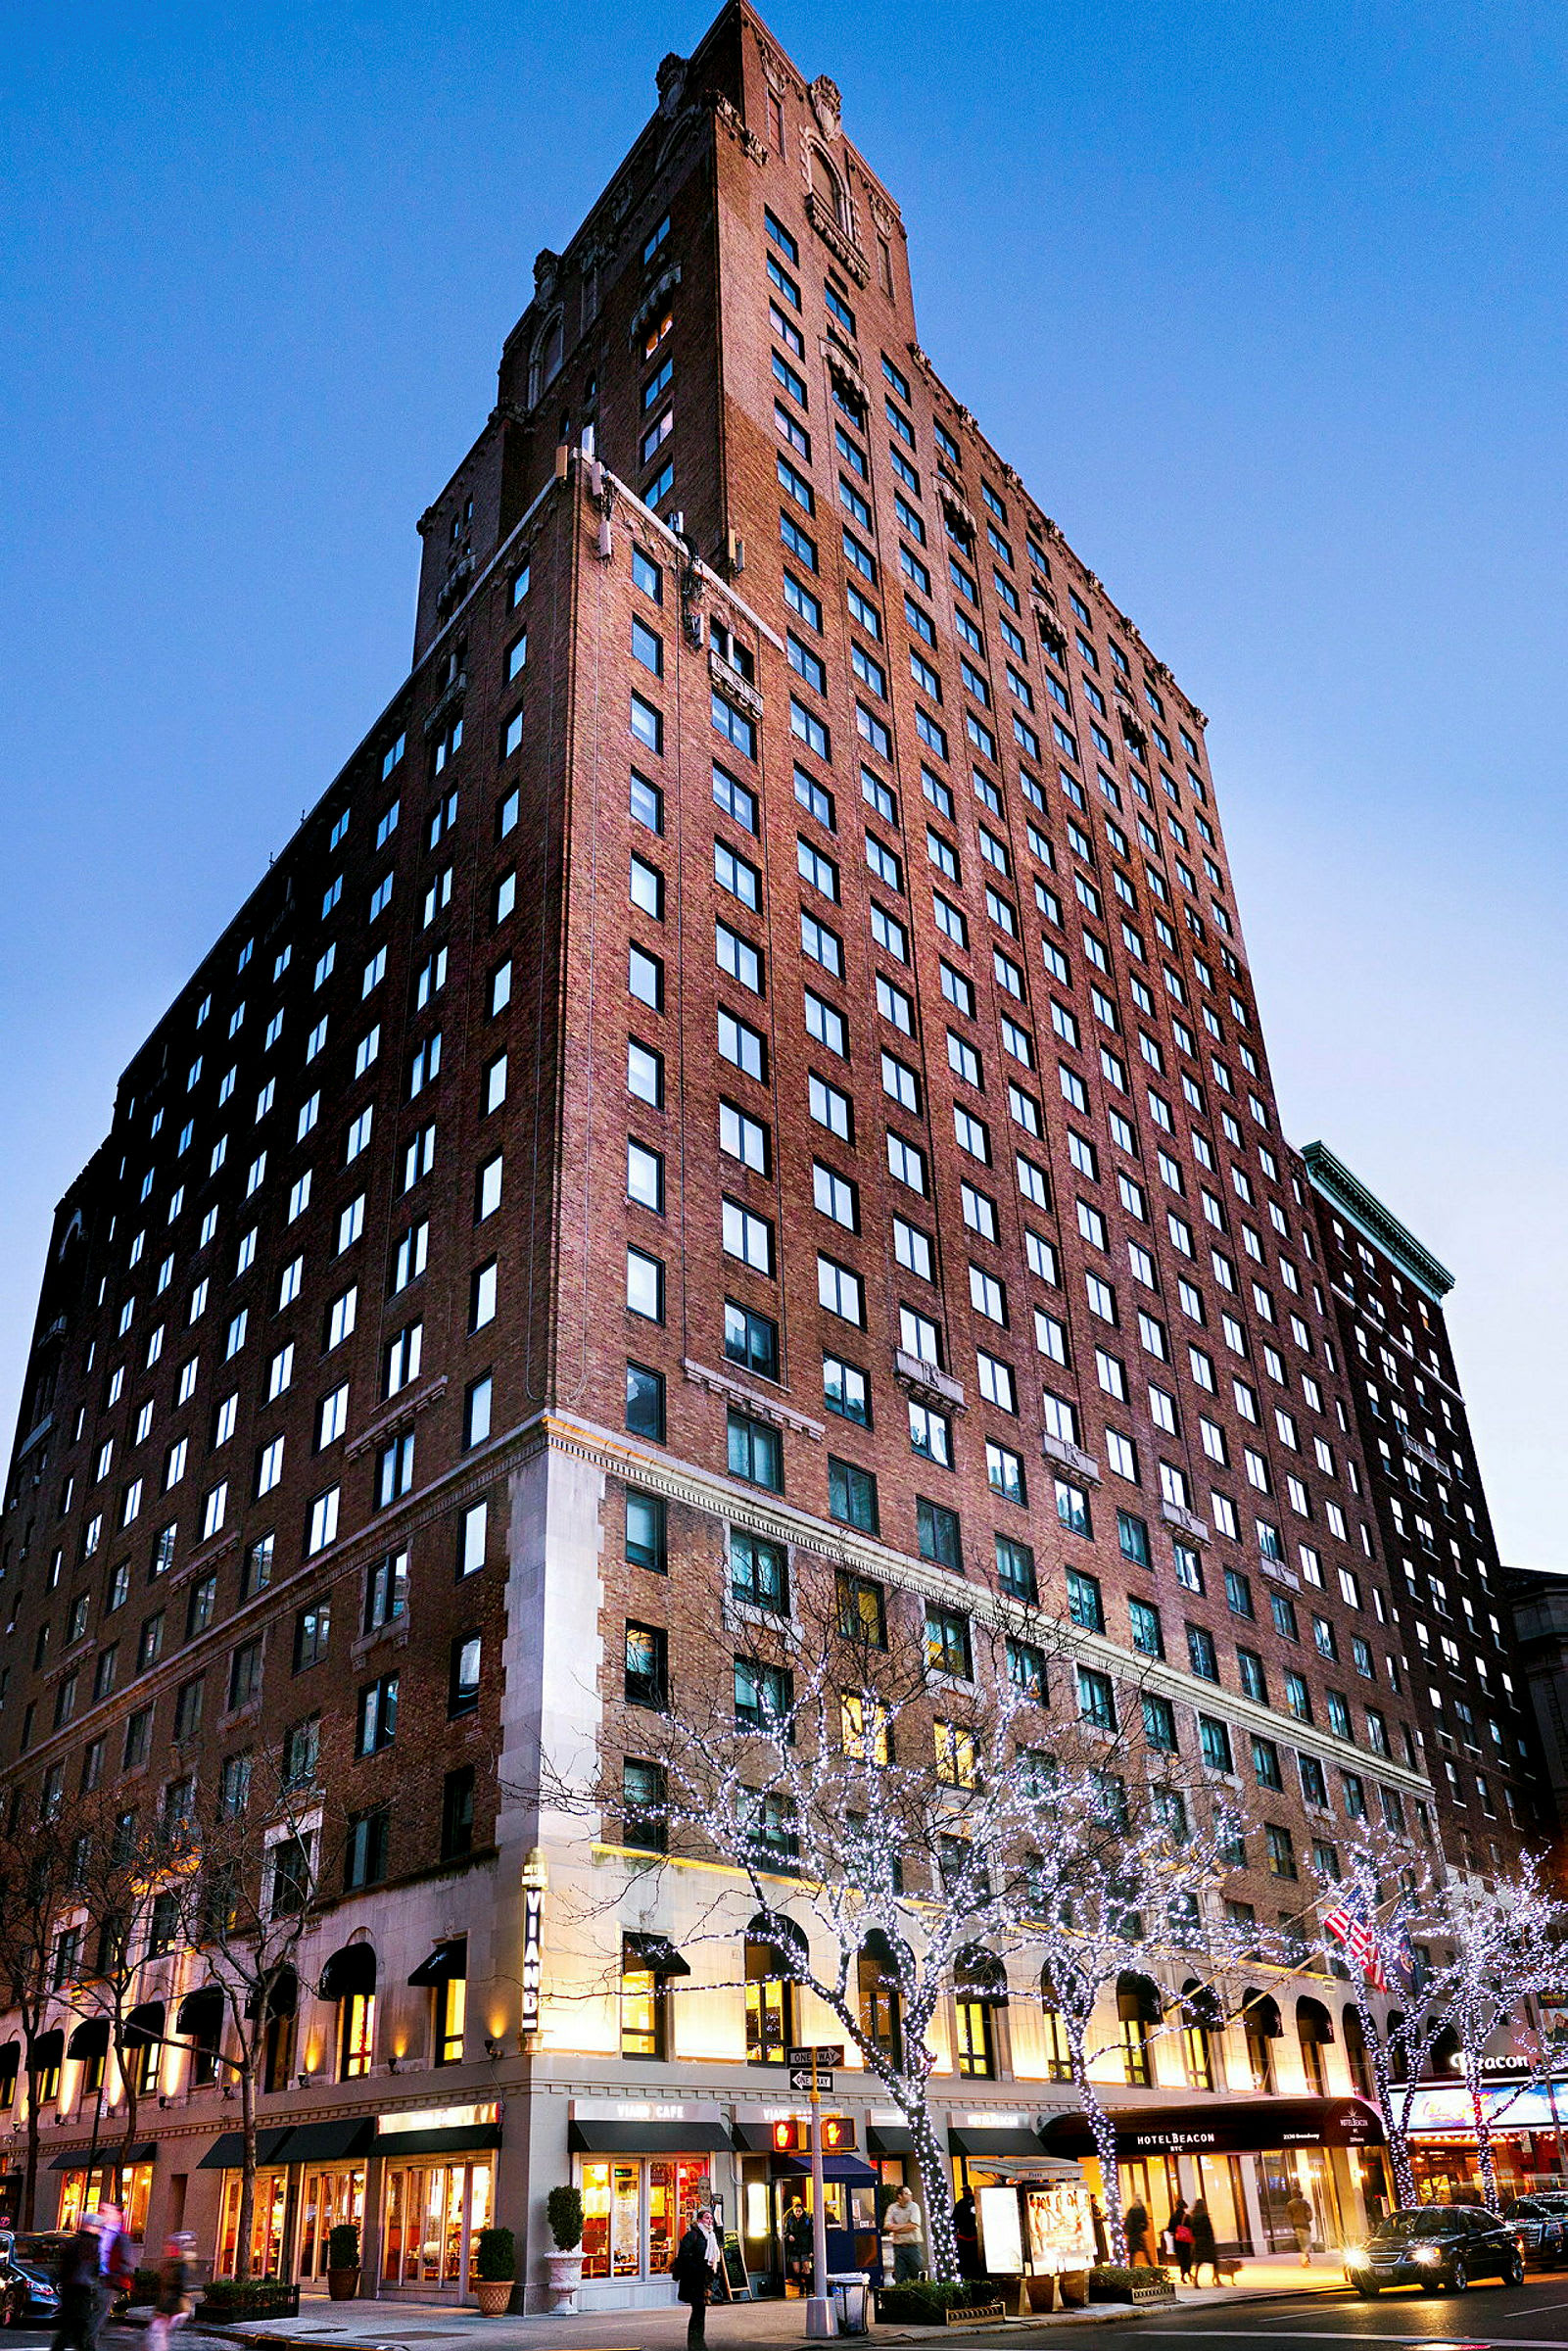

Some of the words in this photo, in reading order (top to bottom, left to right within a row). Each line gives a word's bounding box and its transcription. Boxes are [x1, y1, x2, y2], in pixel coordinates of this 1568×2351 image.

[523, 1891, 541, 2014] VIAND
[794, 2053, 812, 2063] ONE
[818, 2051, 836, 2062] WAY
[796, 2076, 810, 2085] ONE
[617, 2105, 650, 2119] VIAND
[656, 2105, 686, 2119] CAFE
